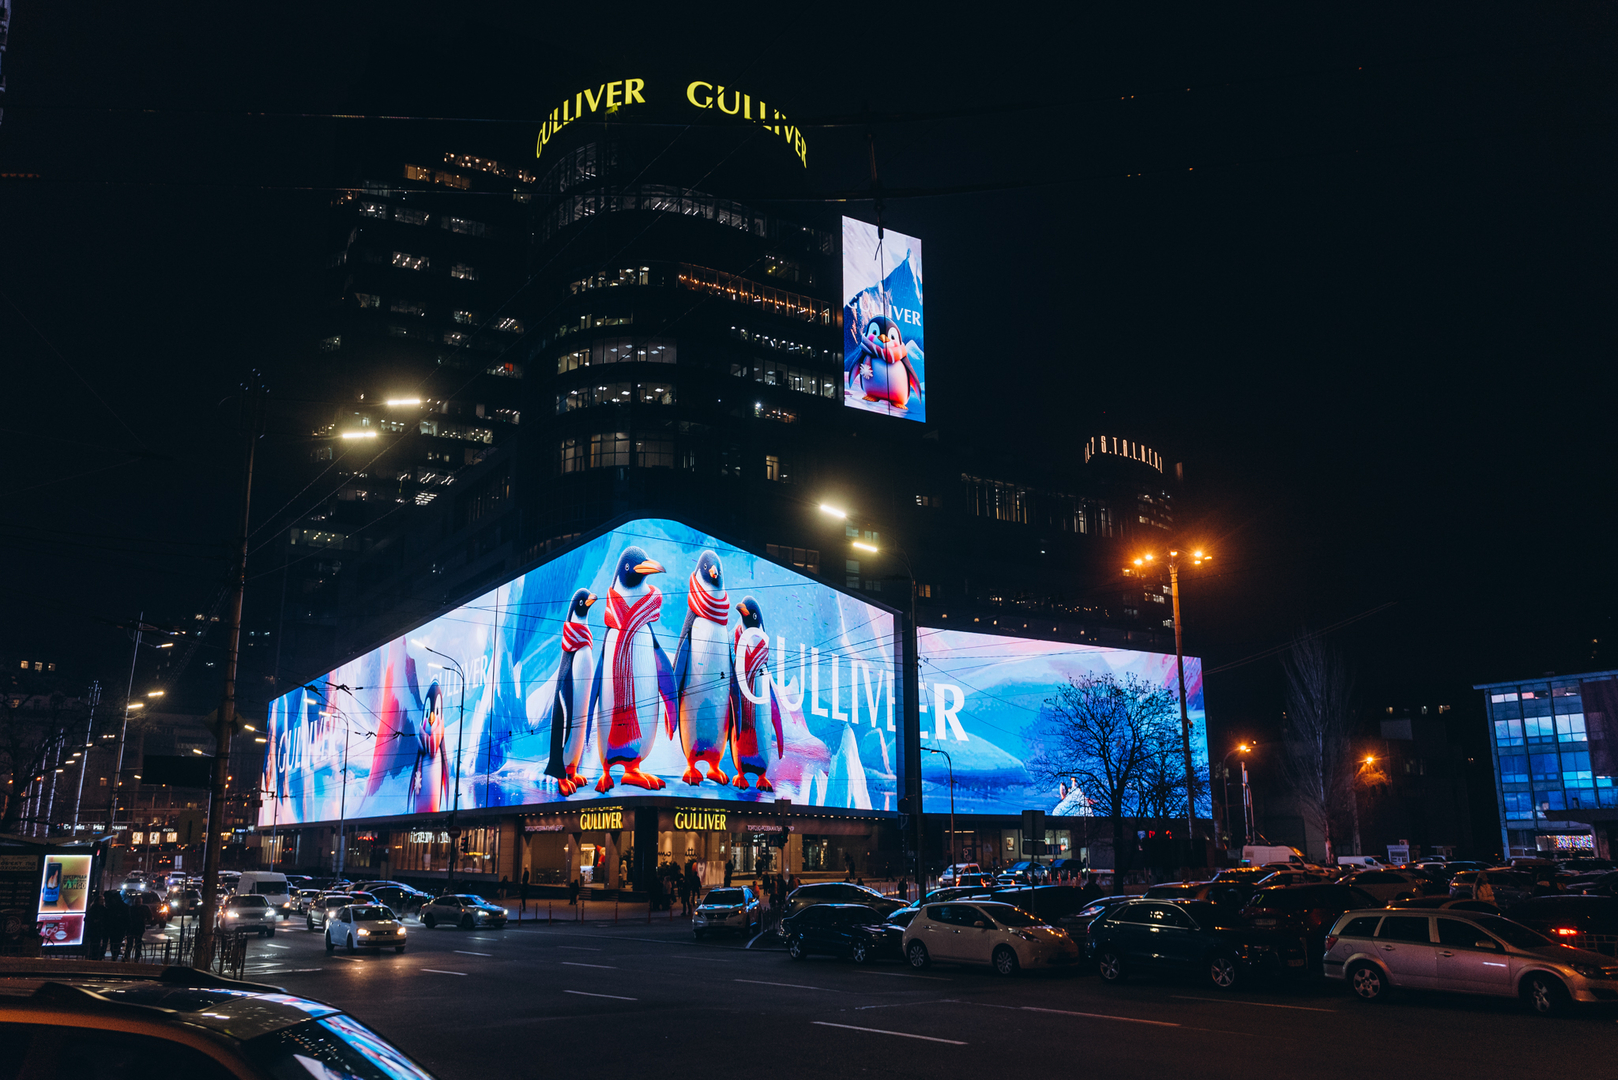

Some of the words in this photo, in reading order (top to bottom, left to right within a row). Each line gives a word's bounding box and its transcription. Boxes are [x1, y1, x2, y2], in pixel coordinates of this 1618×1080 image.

[536, 78, 646, 159] GULLIVER
[686, 80, 808, 169] GULLIVER
[580, 811, 623, 831] GULLIVER
[674, 811, 727, 831] GULLIVER
